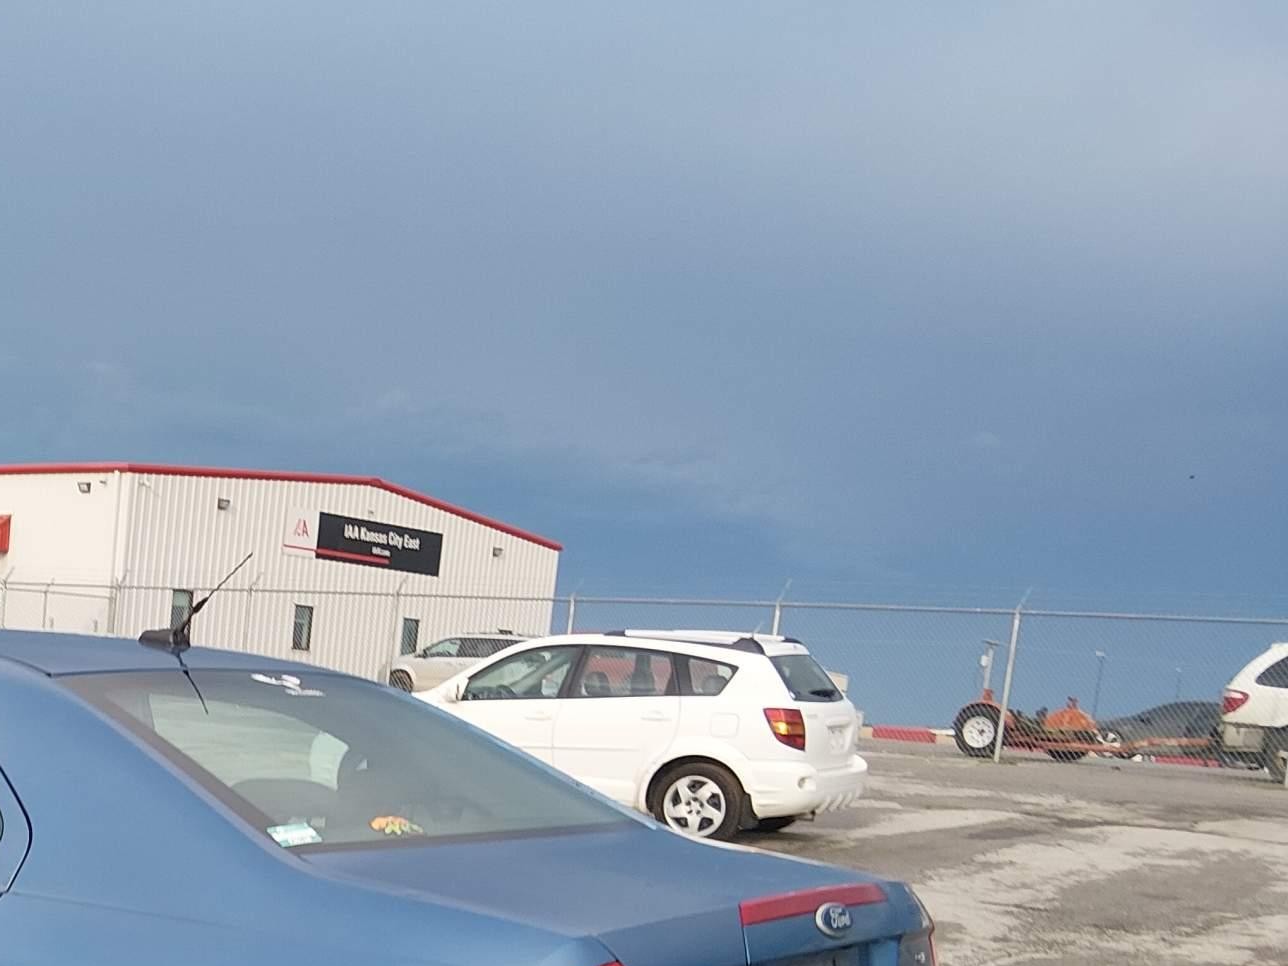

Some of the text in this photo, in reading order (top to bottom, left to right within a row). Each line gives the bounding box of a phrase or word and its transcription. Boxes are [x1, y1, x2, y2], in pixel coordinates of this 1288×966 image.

[360, 526, 388, 545] Kansas
[388, 531, 404, 551] City
[403, 534, 421, 551] East
[829, 907, 851, 929] Ford
